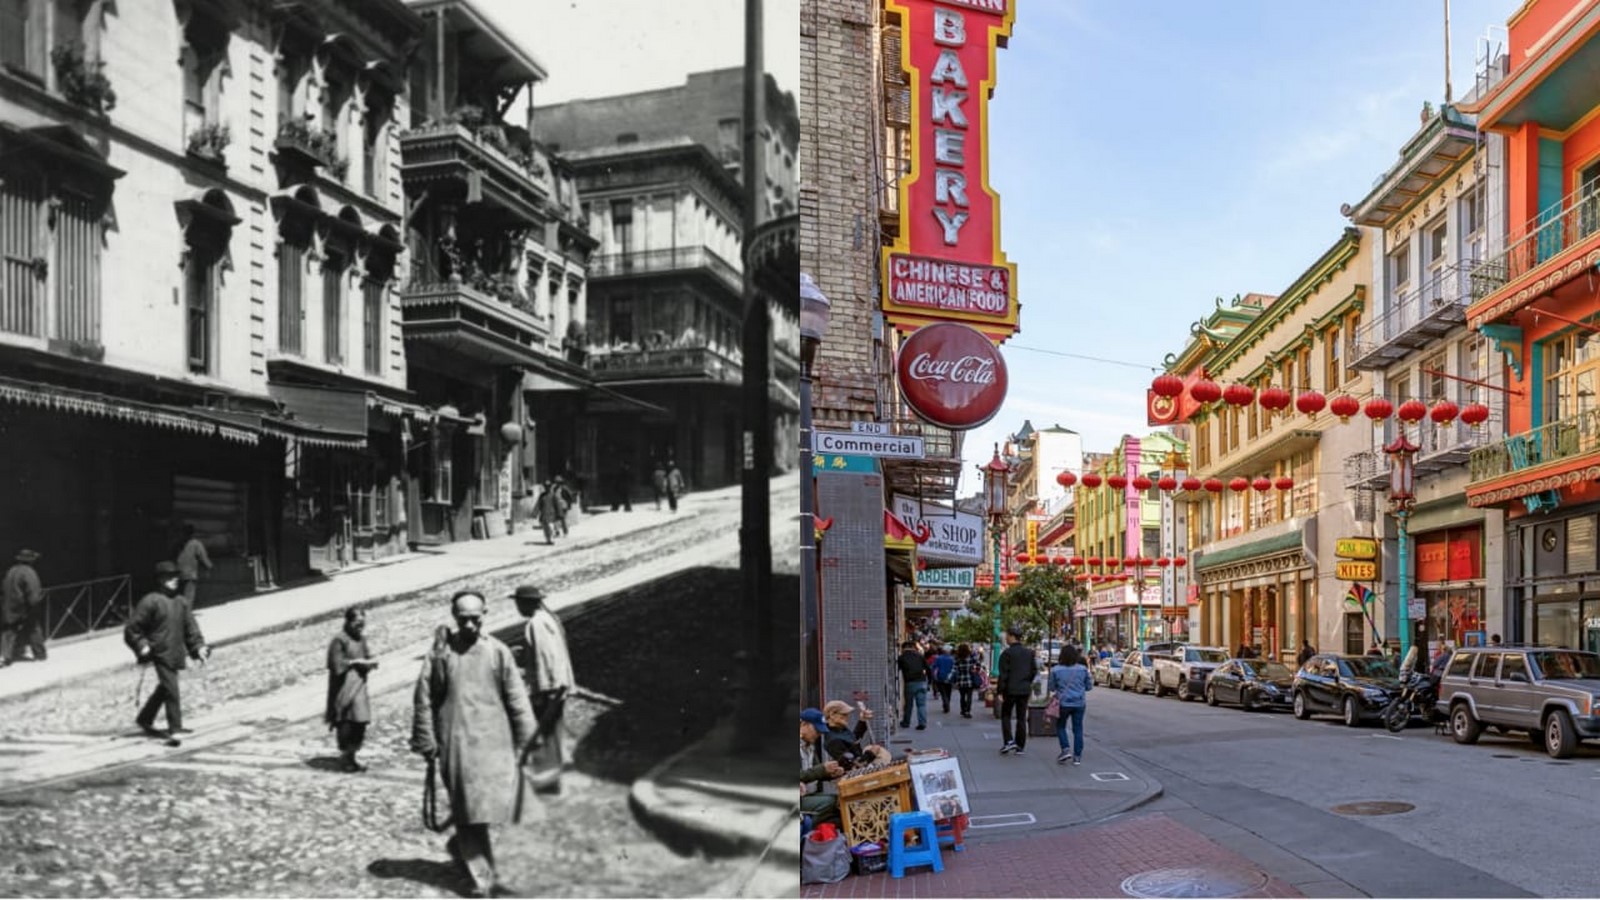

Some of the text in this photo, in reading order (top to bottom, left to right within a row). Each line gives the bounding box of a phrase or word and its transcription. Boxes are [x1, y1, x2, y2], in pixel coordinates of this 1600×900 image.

[931, 8, 969, 246] BAKERY
[895, 258, 1004, 290] CHINESE &
[896, 281, 1006, 312] AMERICAN FOOD
[858, 423, 881, 433] END
[823, 436, 915, 454] Commercial
[902, 502, 914, 514] the
[942, 522, 978, 546] SHOP
[917, 569, 957, 585] ARDEN
[1341, 564, 1373, 578] KITES
